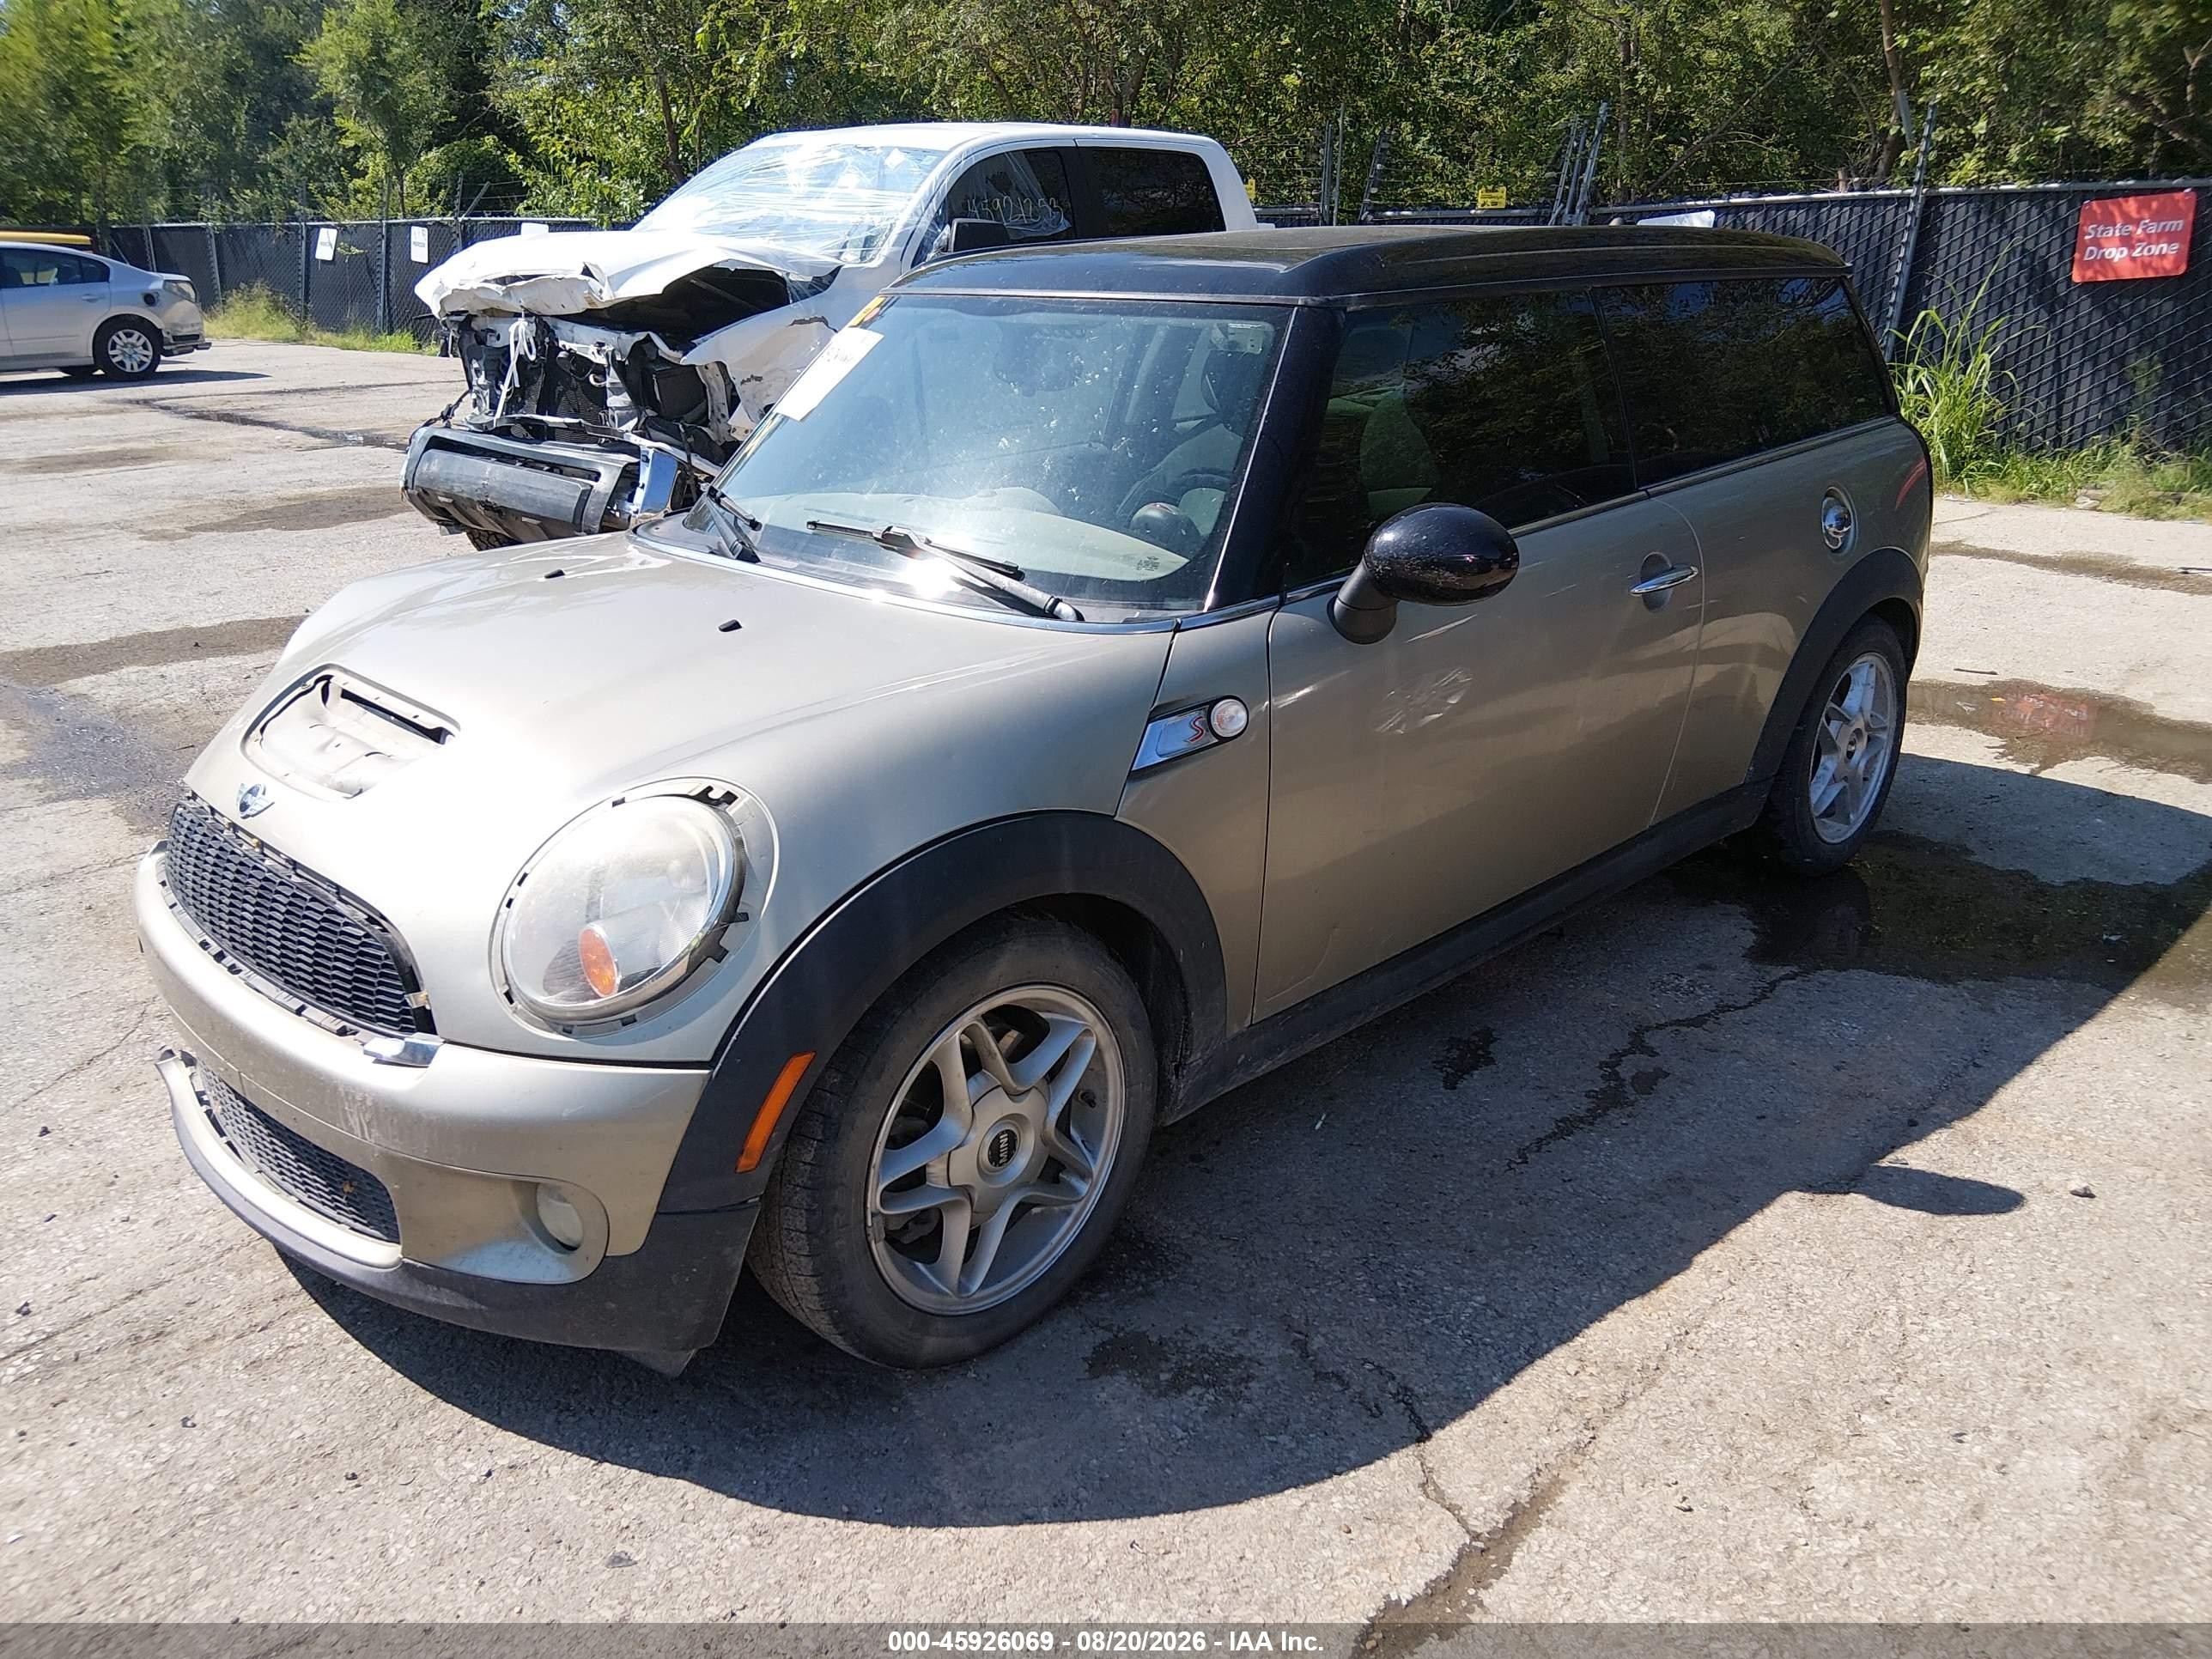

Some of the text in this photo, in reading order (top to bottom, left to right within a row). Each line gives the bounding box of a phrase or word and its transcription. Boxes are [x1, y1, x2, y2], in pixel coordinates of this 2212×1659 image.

[2084, 219, 2185, 240] State Farm
[2083, 241, 2180, 263] Drop Zone
[1187, 715, 1206, 744] S
[999, 1133, 1009, 1164] MINI
